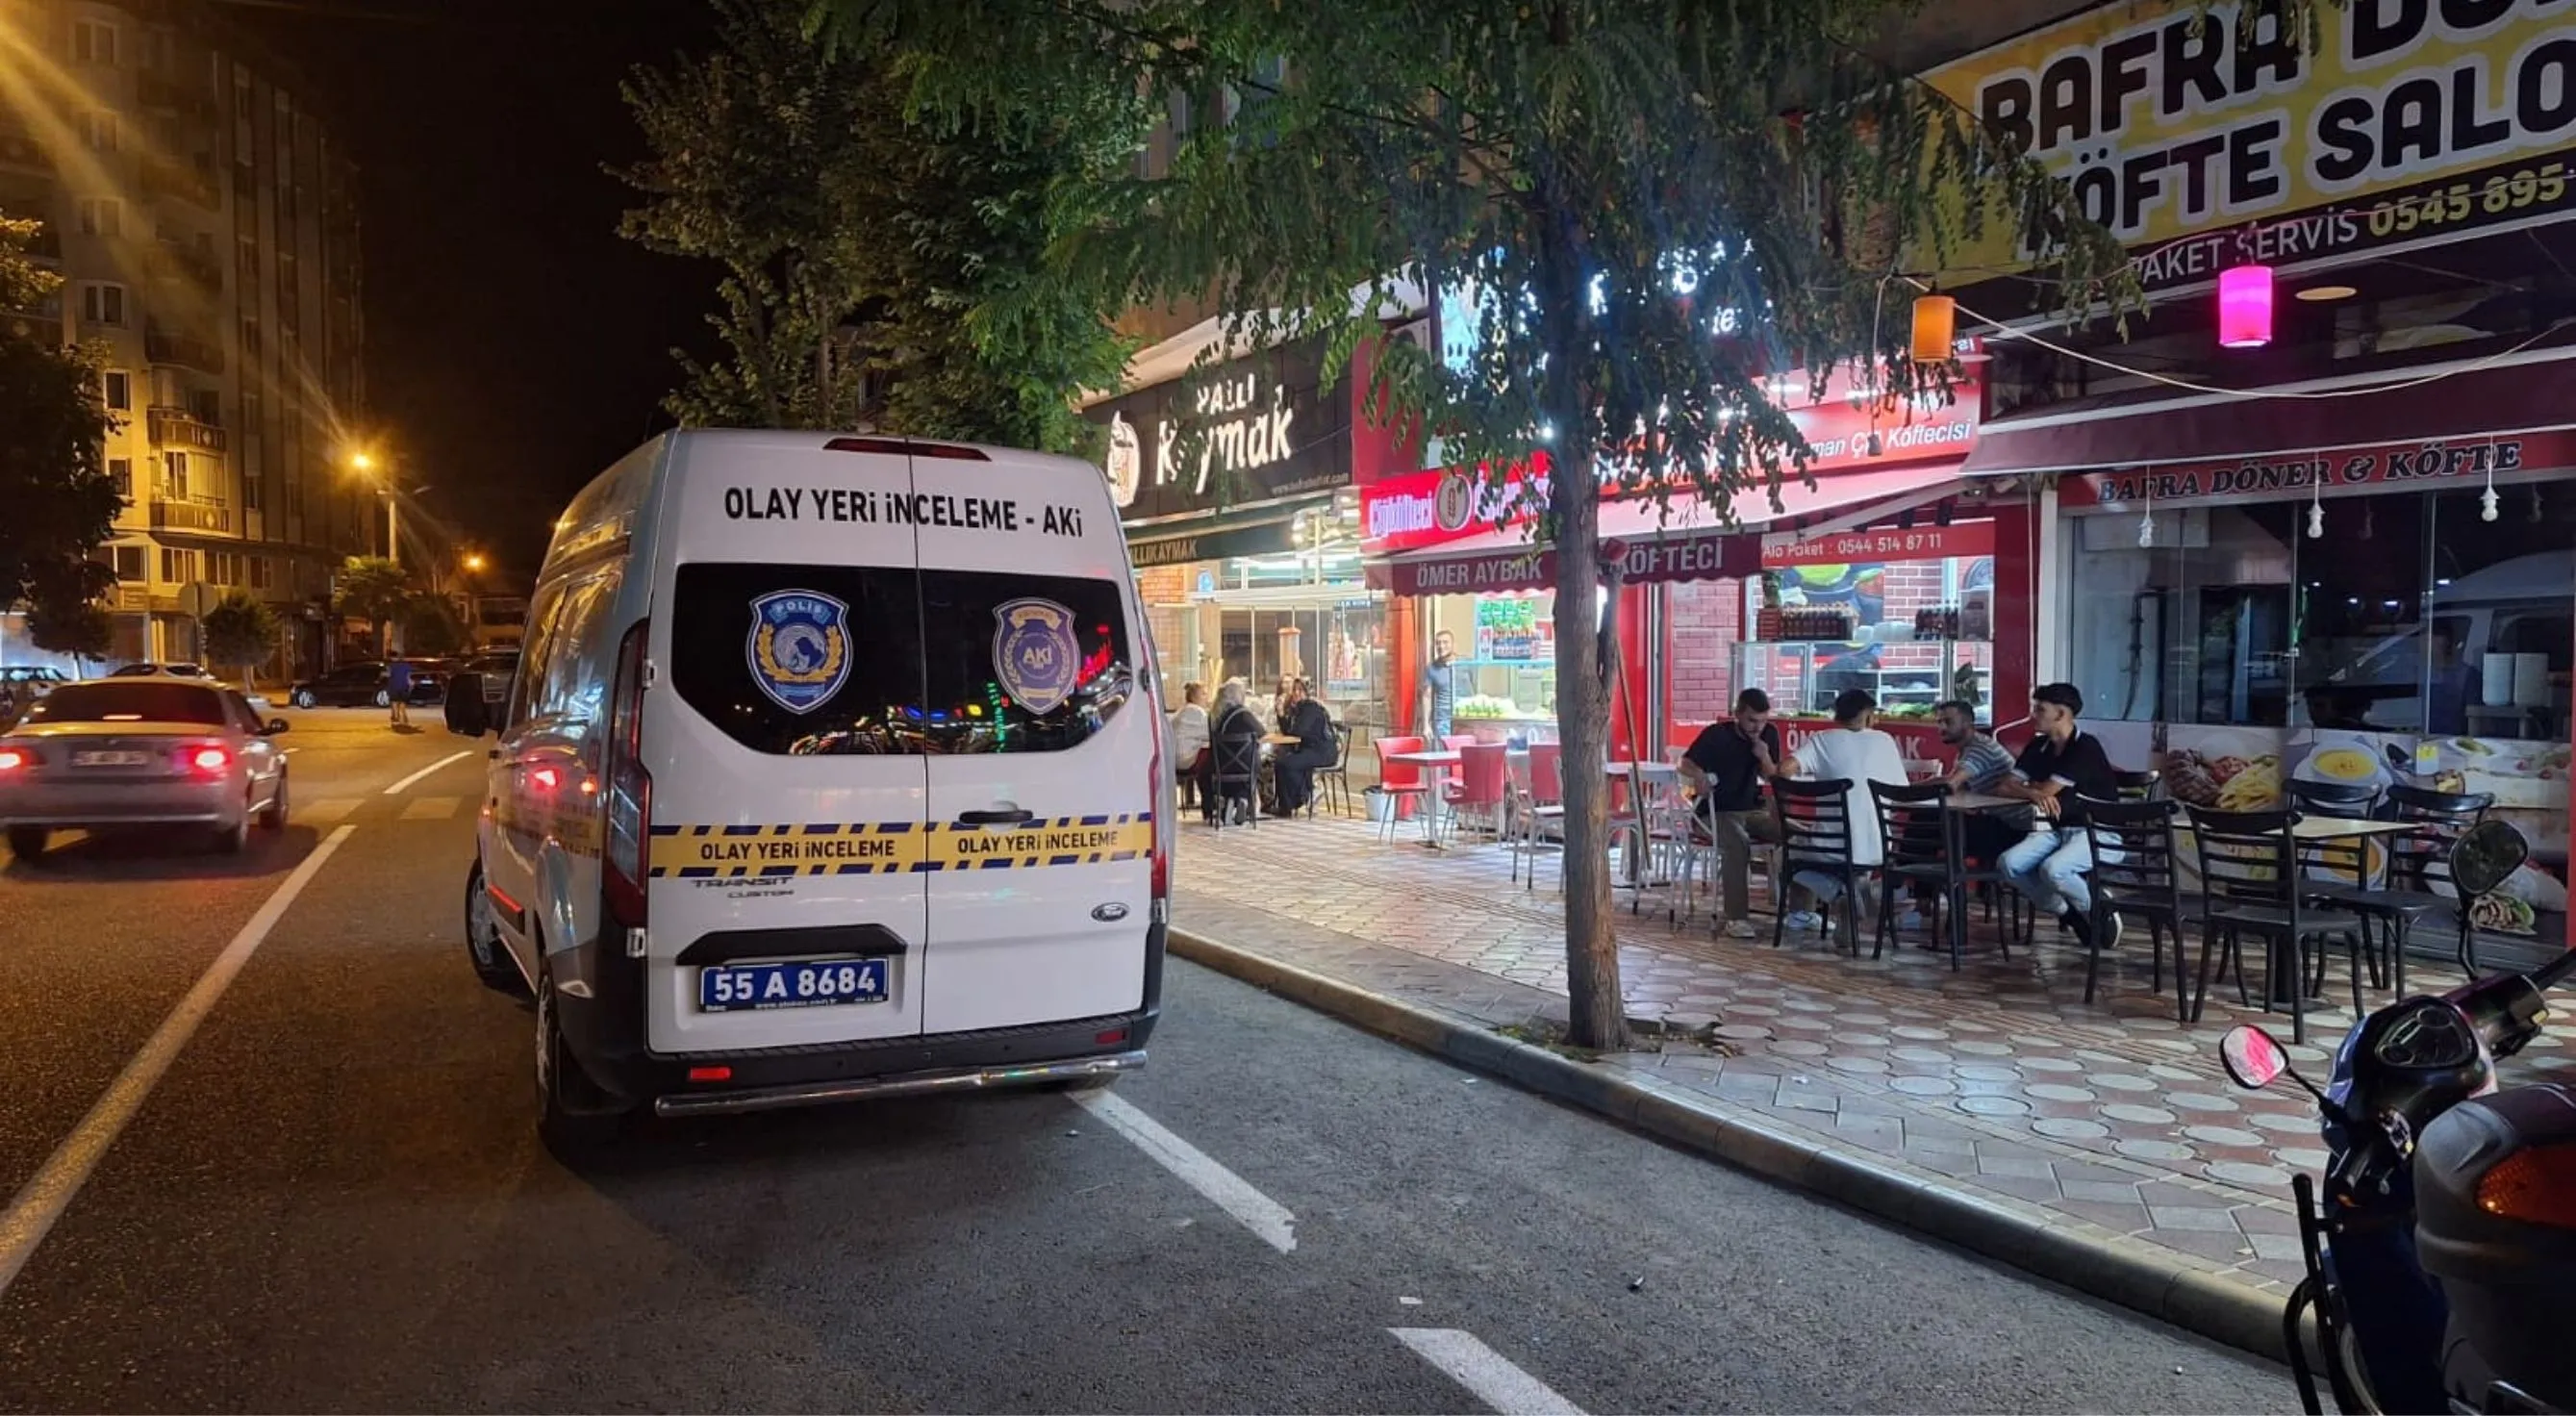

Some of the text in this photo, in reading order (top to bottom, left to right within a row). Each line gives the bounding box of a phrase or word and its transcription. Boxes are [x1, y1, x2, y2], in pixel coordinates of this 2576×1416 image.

[1982, 1, 2300, 152] BAFRA
[2368, 183, 2470, 237] 0545
[2483, 164, 2565, 214] 895
[1885, 419, 1971, 449] Köftecisi
[2098, 440, 2521, 502] BAFRA DÖNER & KÖFTE
[724, 488, 802, 519] OLAY
[1762, 544, 1783, 559] Alo
[1787, 542, 1824, 558] Paket
[1837, 538, 1872, 555] 0544
[1877, 536, 1901, 553] 514
[1906, 534, 1924, 550] 87
[1928, 533, 1942, 548] 11
[1416, 556, 1544, 589] ÖMER AYBAK
[700, 843, 753, 860] OLAY
[957, 836, 1001, 854] OLAY
[714, 965, 877, 1002] 55 A 8684
